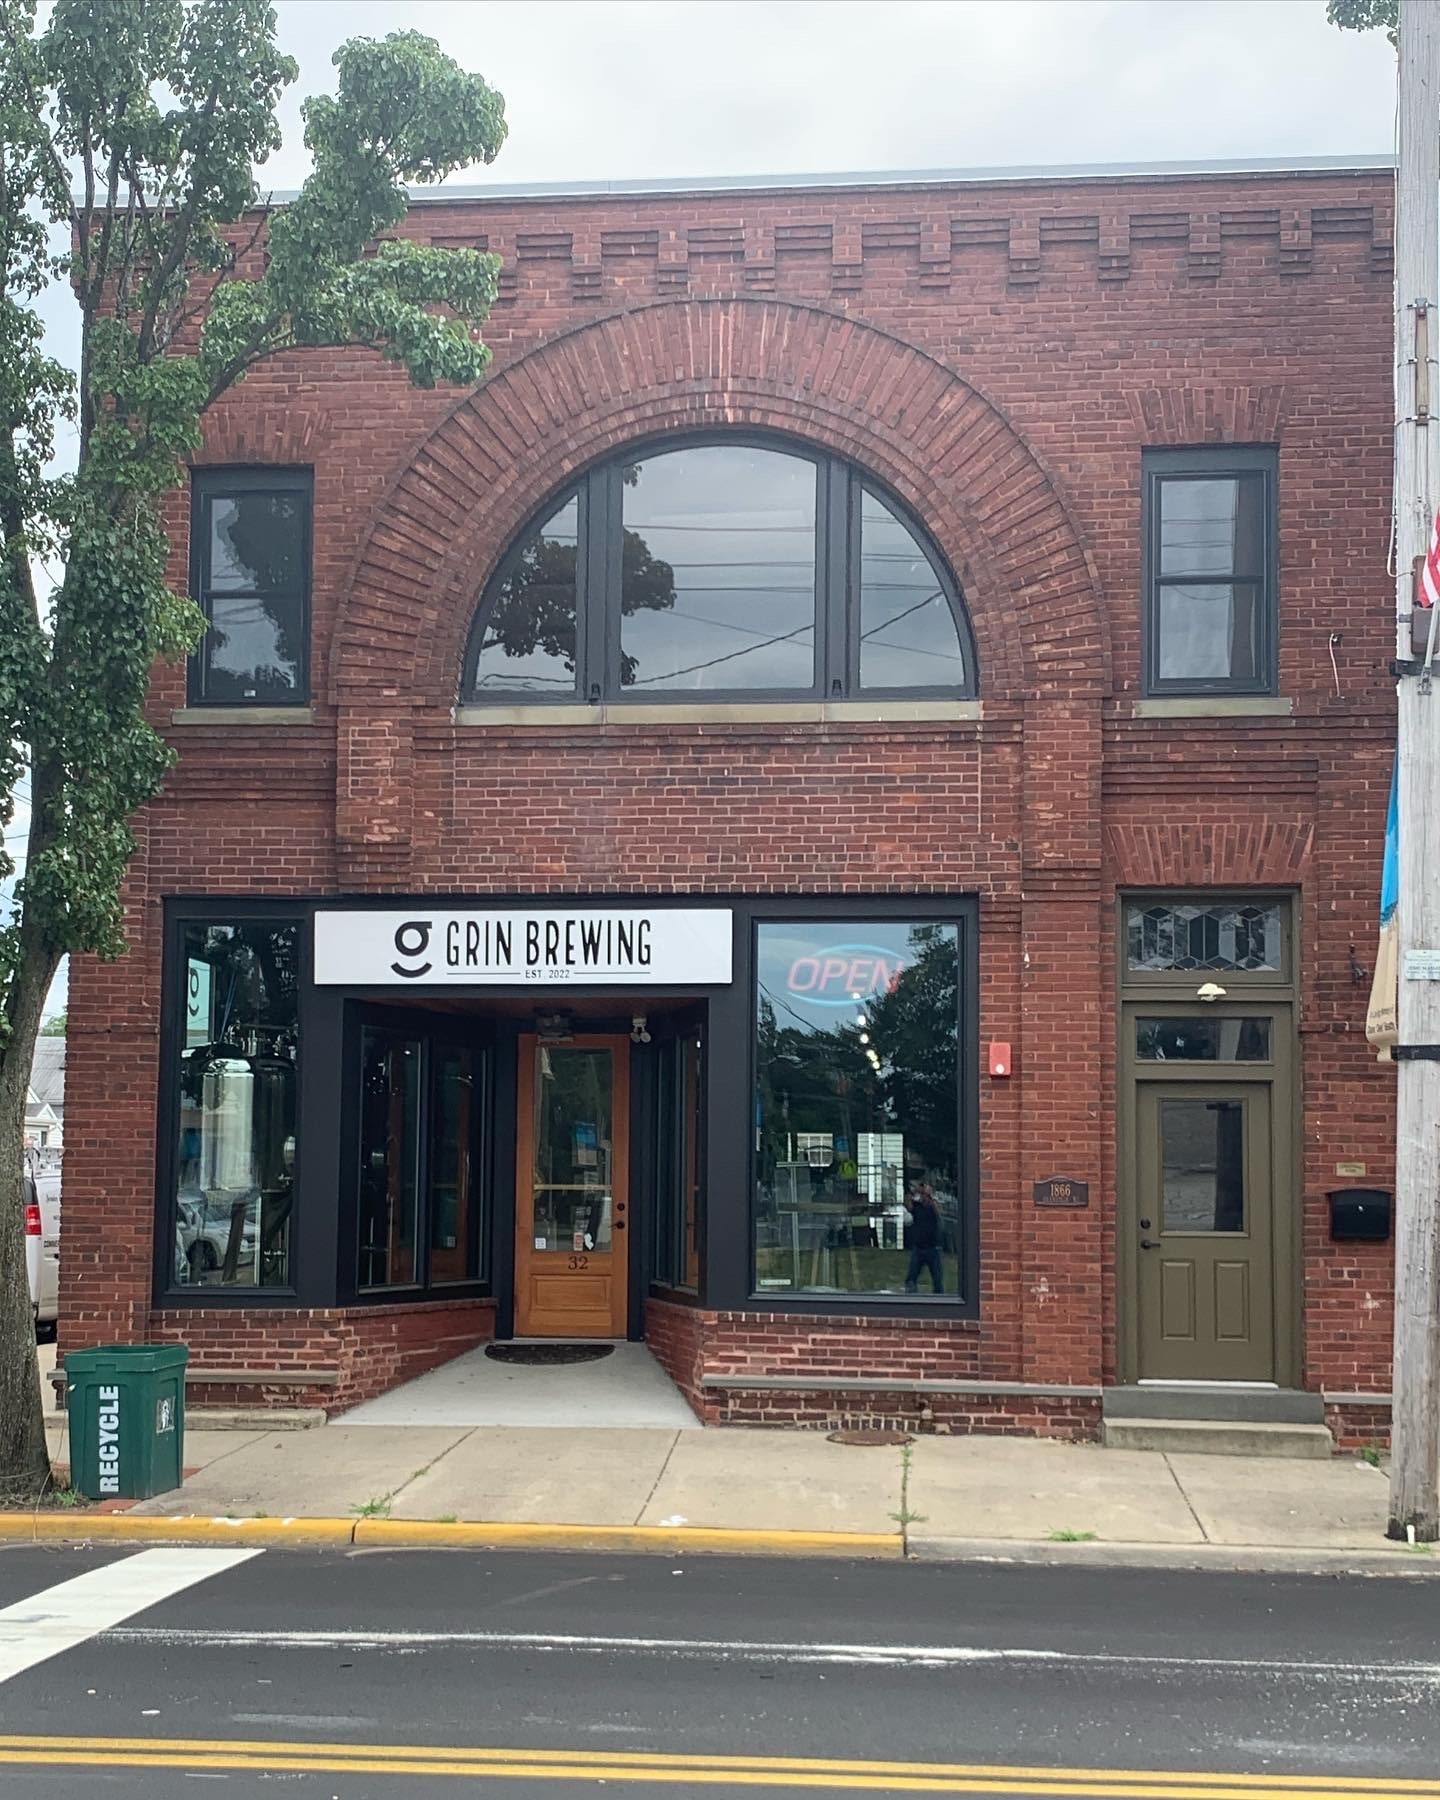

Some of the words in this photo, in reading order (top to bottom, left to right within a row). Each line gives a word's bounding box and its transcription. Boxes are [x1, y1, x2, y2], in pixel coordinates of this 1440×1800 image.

[446, 920, 512, 967] GRIN
[526, 919, 651, 967] BREWING
[548, 969, 570, 979] 2022
[787, 957, 905, 993] OPEN
[1050, 1183, 1071, 1197] 1866
[568, 1255, 588, 1270] 32
[98, 1385, 120, 1493] RECYCLE
